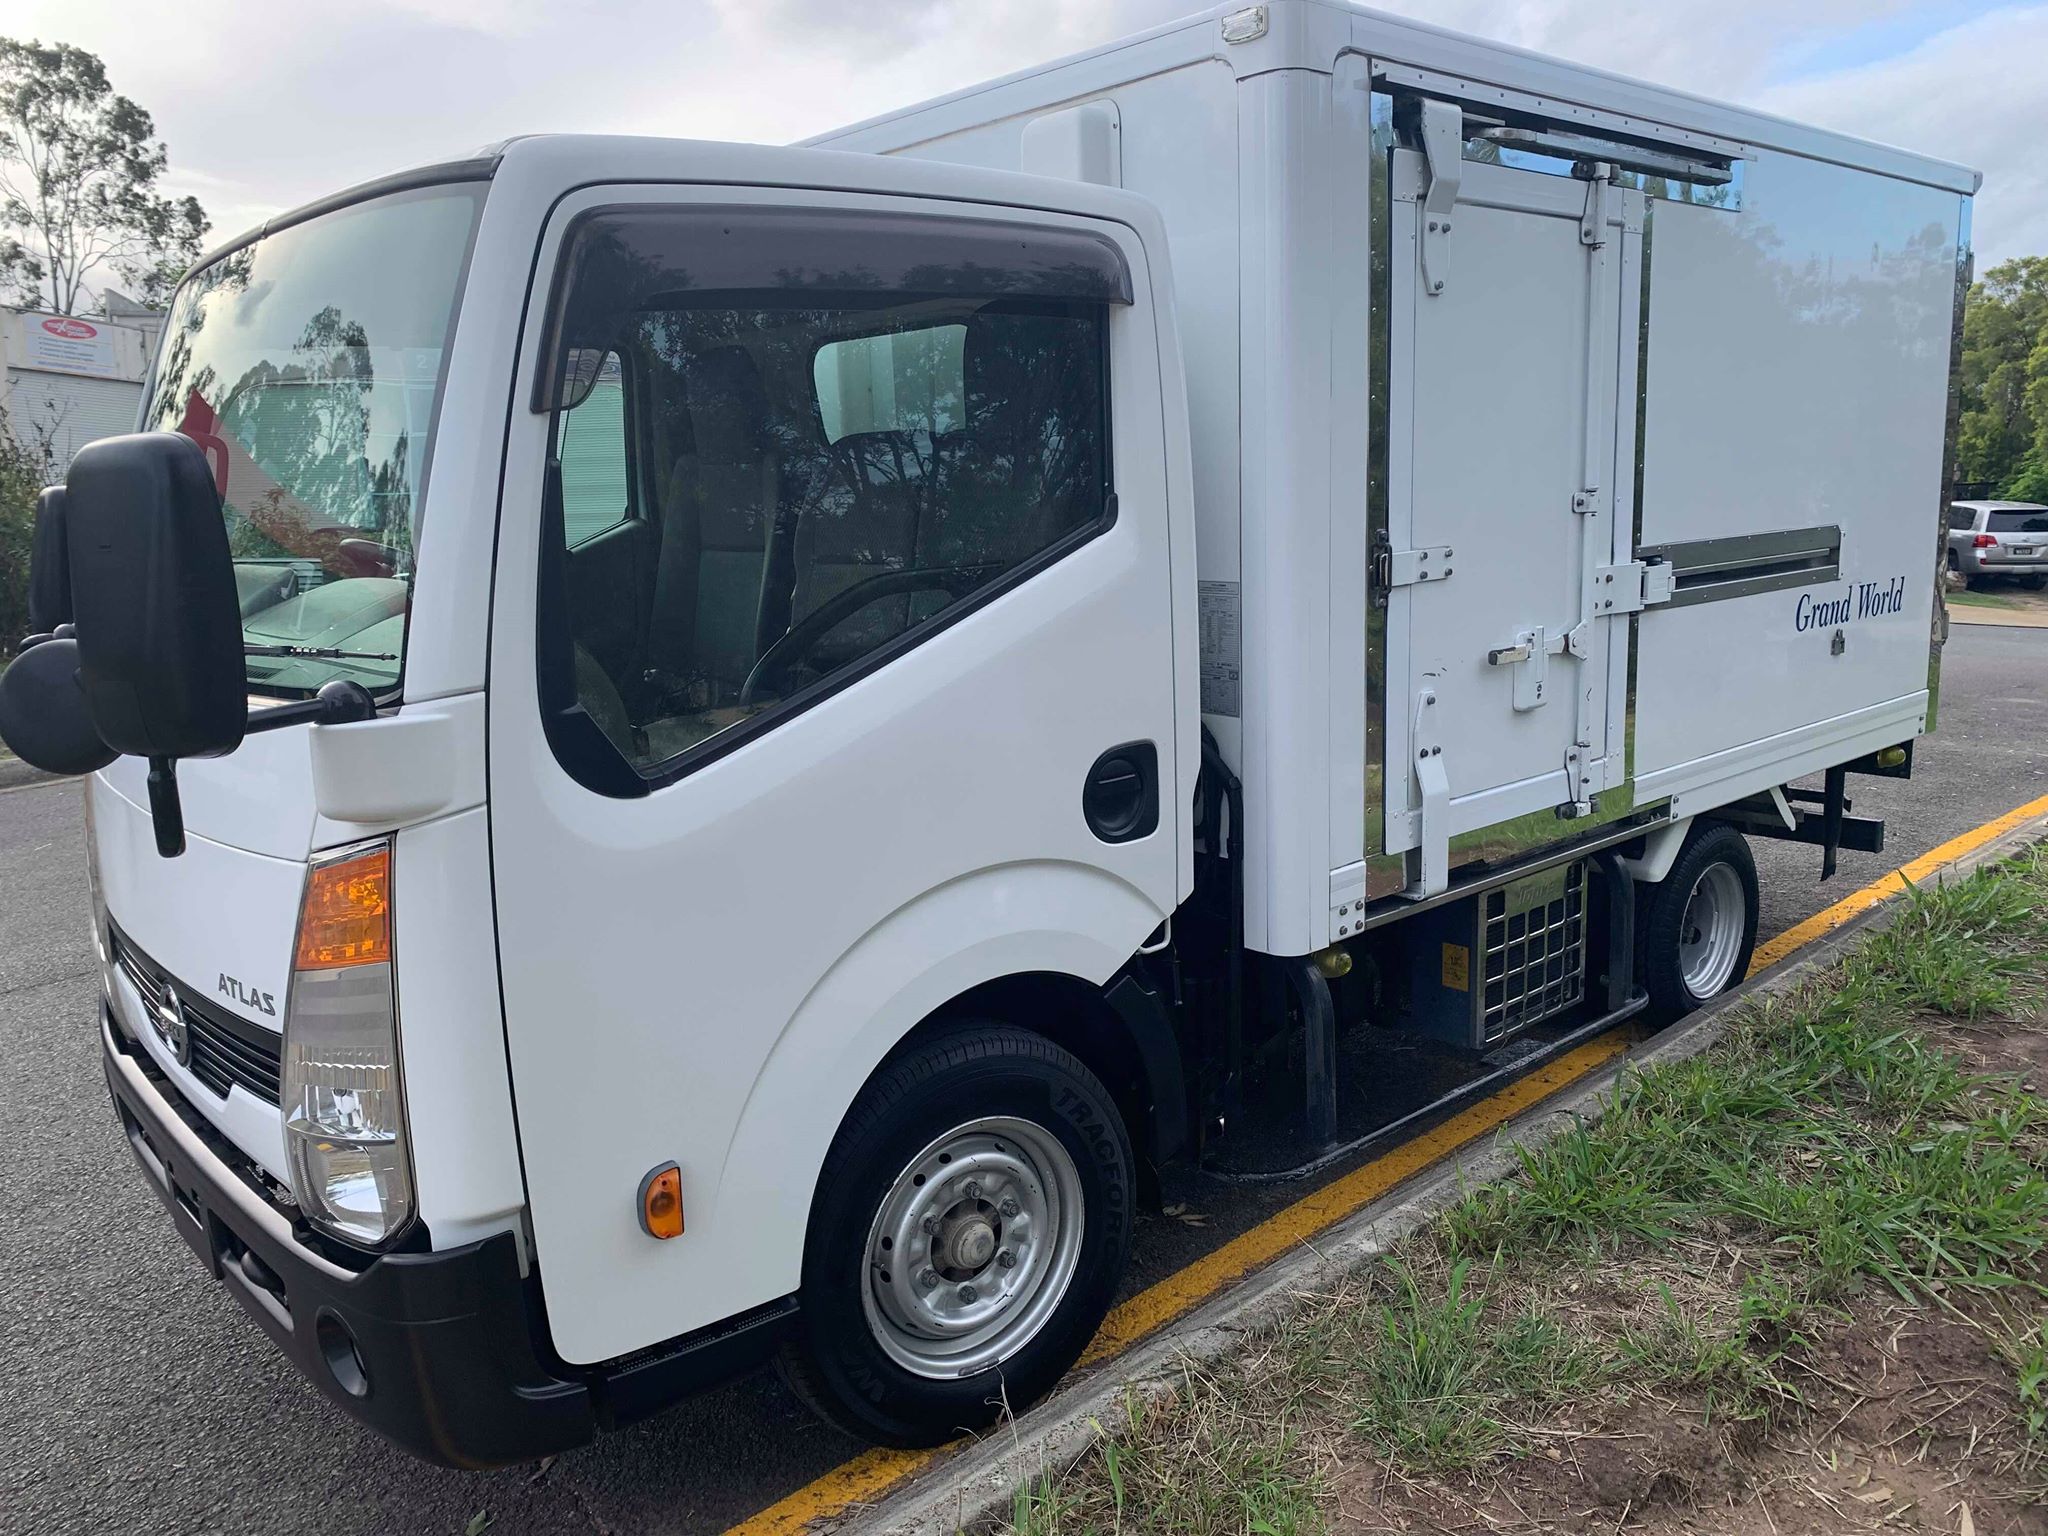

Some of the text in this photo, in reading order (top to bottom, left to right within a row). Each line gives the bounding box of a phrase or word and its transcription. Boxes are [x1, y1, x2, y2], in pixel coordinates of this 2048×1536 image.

[1795, 576, 1905, 632] Grand World
[218, 972, 276, 1017] ATLAS
[1055, 1086, 1125, 1265] TRACFORC
